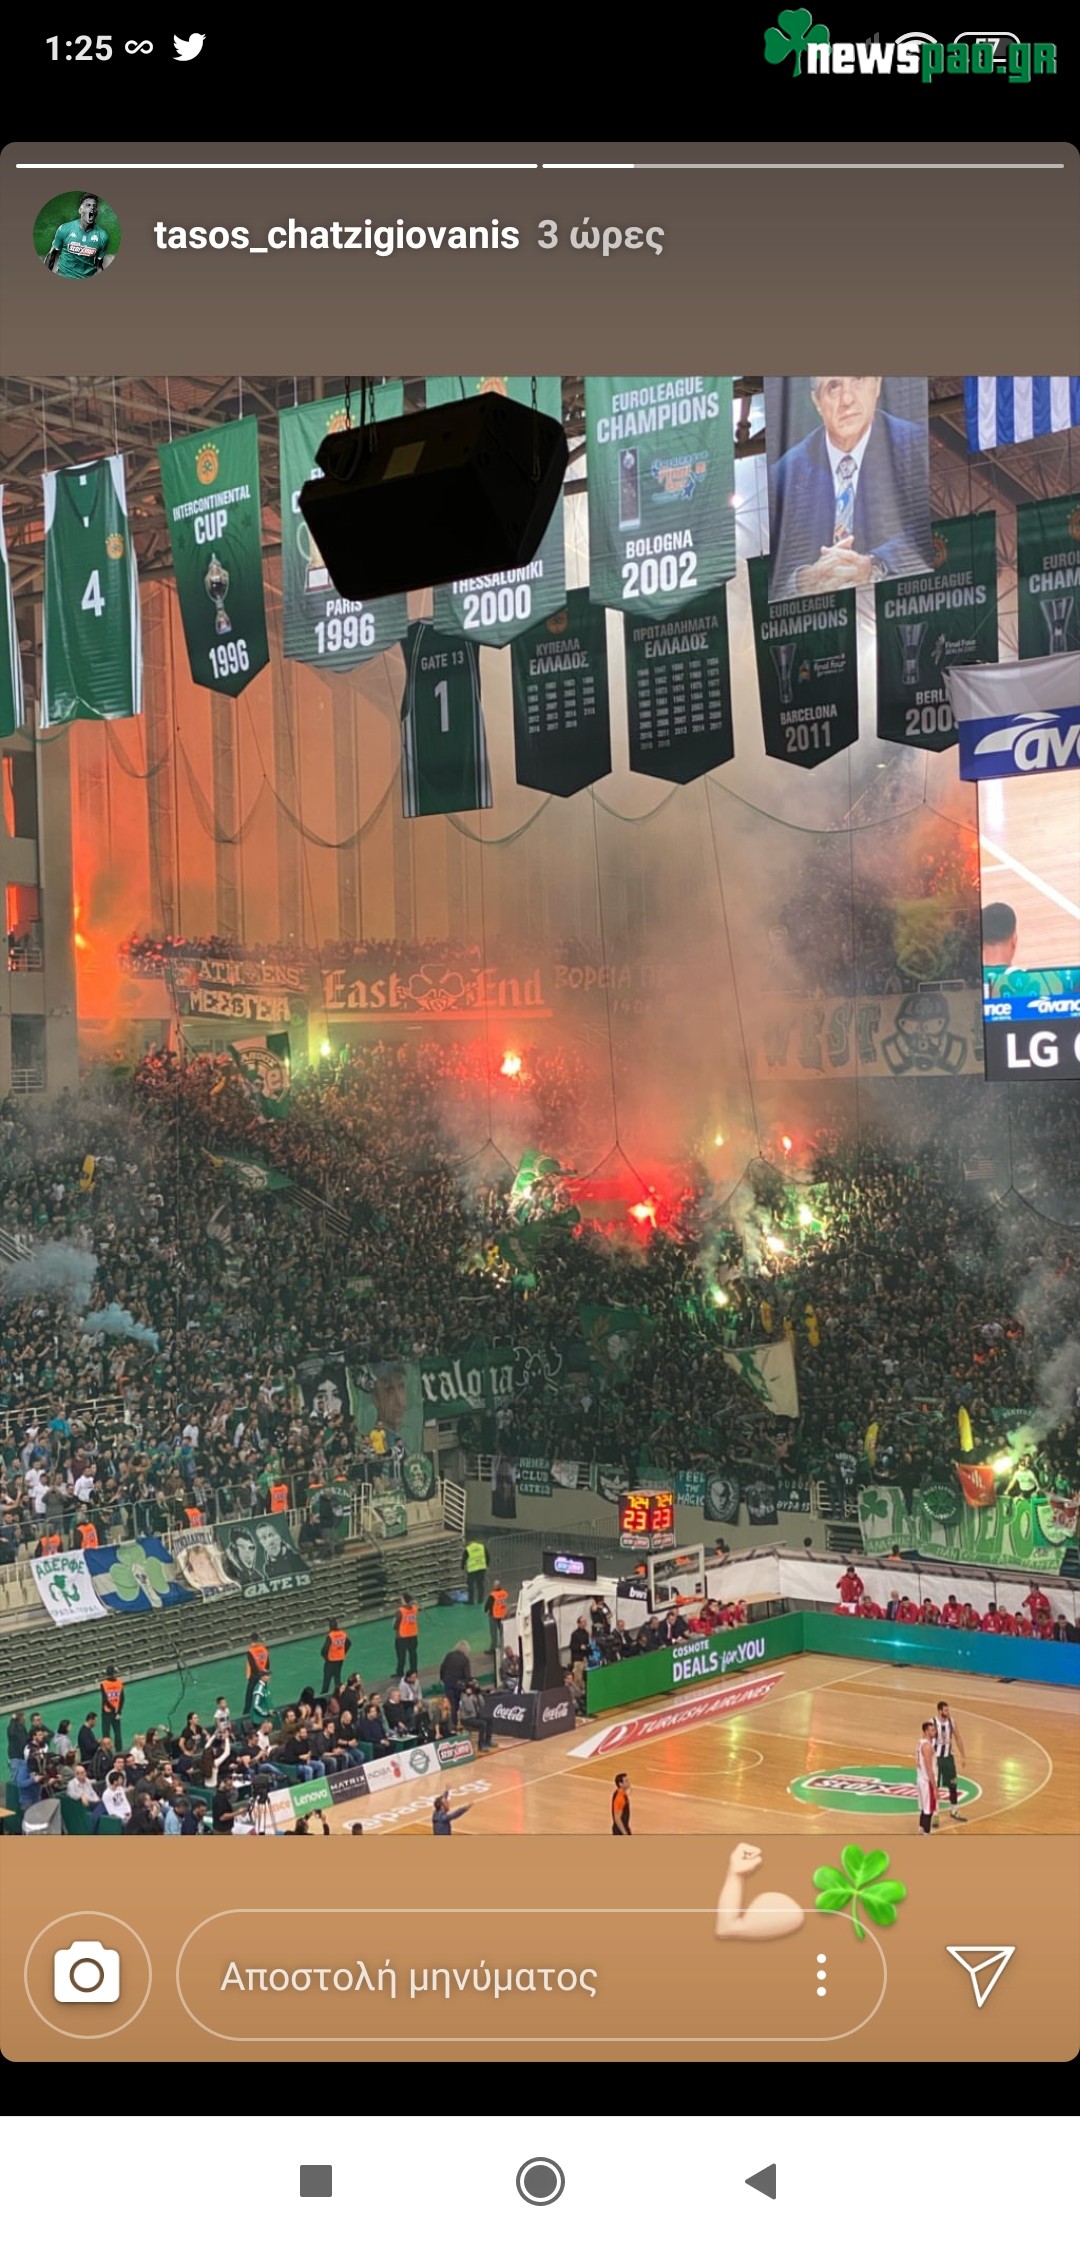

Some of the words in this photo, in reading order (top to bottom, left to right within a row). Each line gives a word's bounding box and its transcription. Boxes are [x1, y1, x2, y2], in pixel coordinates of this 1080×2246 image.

[612, 376, 703, 413] EUROLEAGUE
[597, 391, 720, 444] CHAMPIONS
[173, 484, 251, 522] INTERCONTINENTAL
[194, 509, 228, 545] CUP
[625, 529, 693, 560] BOLOGNA
[453, 560, 543, 594] THESSALONIKI
[622, 551, 698, 600] 2002
[897, 571, 973, 596] EUROLEAGUE
[81, 569, 106, 617] 4
[326, 599, 363, 617] PARIS
[463, 584, 531, 630] 2000
[769, 594, 836, 618] EUROLEAGUE
[884, 585, 987, 619] CHAMPIONS
[314, 613, 375, 653] 1996
[633, 616, 719, 641] ΠΡΩΤΑΘΛΗΜΑΤΑ
[761, 608, 848, 640] CHAMPIONS
[209, 639, 250, 679] 1996
[421, 653, 448, 671] GATE
[452, 650, 464, 665] 13
[536, 638, 580, 656] ΚΥΠΕΛΛΑ
[645, 632, 709, 658] ΕΛΛΑΔΟΣ
[529, 651, 590, 676] ΕΛΛΑΔΟΣ
[434, 680, 449, 732] 1
[780, 704, 838, 725] BARCELONA
[905, 704, 959, 736] 200
[785, 721, 831, 753] 2011
[1014, 724, 1080, 771] av
[321, 968, 403, 1010] East
[466, 967, 545, 1007] End
[1006, 1030, 1059, 1069] LG
[522, 1469, 549, 1482] CLUB
[679, 1470, 706, 1483] FEEL
[677, 1493, 705, 1506] MAGIC
[623, 1510, 647, 1530] 23
[652, 1509, 671, 1529] 23
[244, 1577, 293, 1598] GATE
[295, 1573, 311, 1587] 13
[673, 1640, 709, 1658] COSMOTE
[673, 1651, 718, 1682] DEALS
[720, 1649, 740, 1672] for
[738, 1638, 766, 1661] YOU
[636, 1704, 704, 1737] TURKISH
[703, 1682, 775, 1714] AIRLINES
[293, 1789, 327, 1806] Lenovo
[330, 1775, 365, 1790] MATRIX
